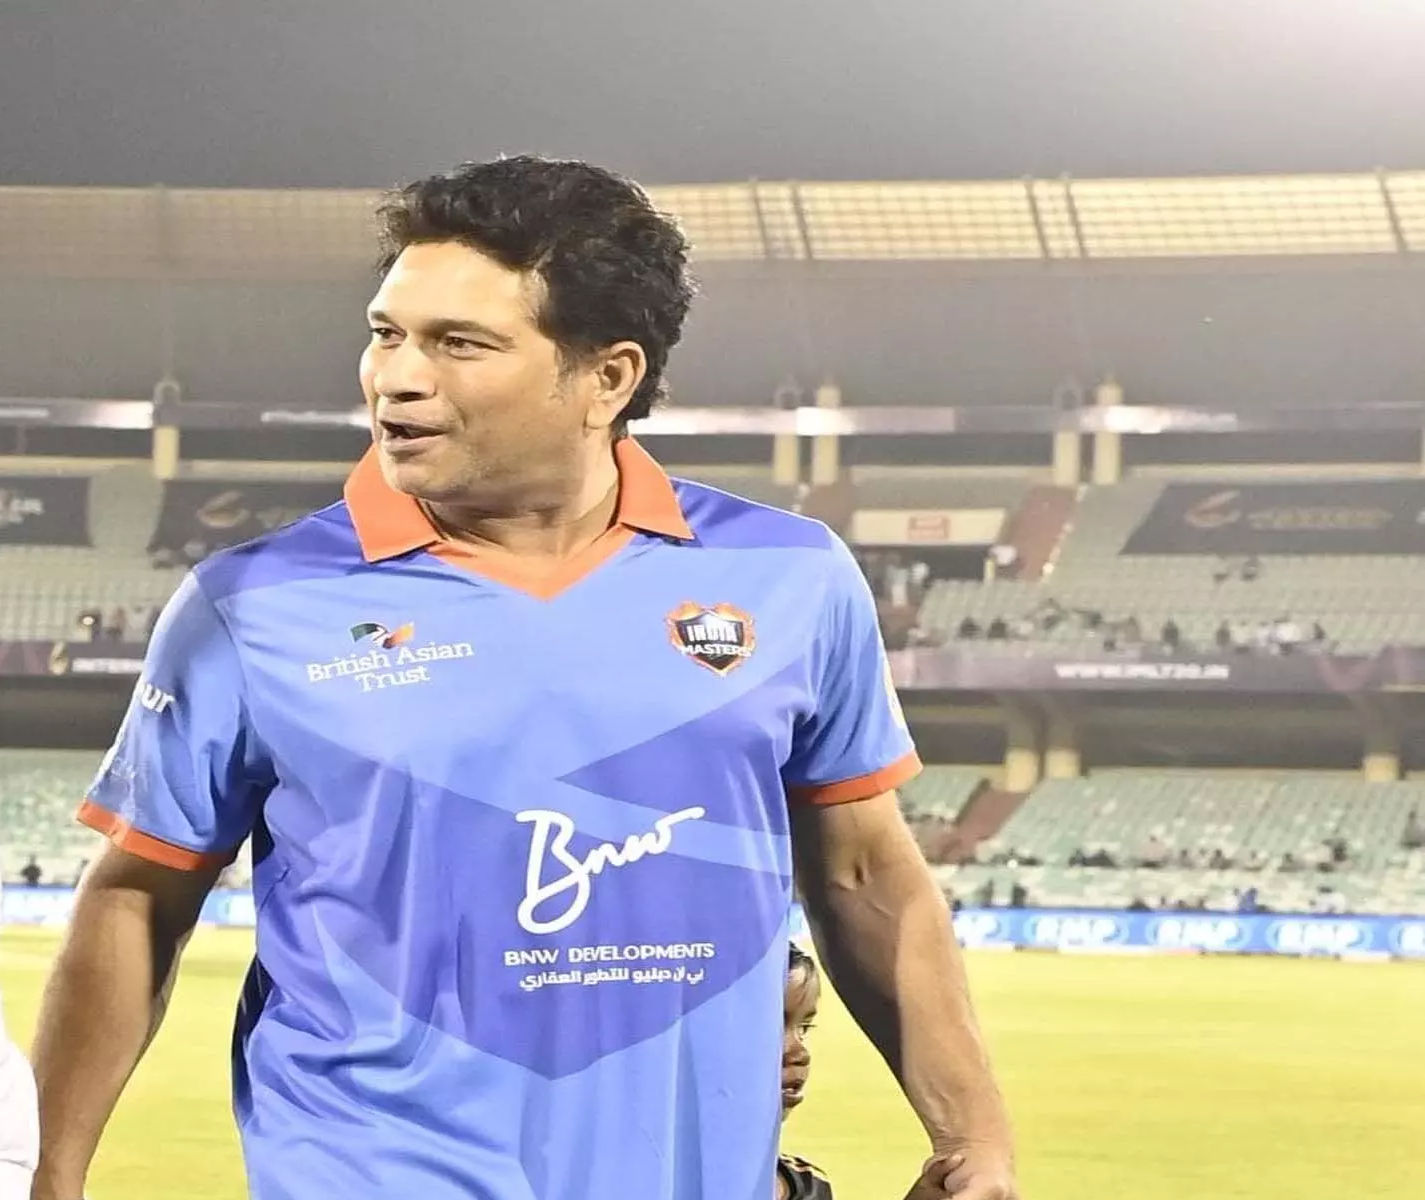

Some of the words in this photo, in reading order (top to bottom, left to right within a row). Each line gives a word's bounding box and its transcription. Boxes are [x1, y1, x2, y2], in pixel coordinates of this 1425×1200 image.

[306, 649, 391, 683] British
[397, 641, 474, 666] Asian
[355, 665, 431, 692] Trust
[504, 949, 560, 967] BNW
[568, 943, 716, 964] DEVELOPMENTS
